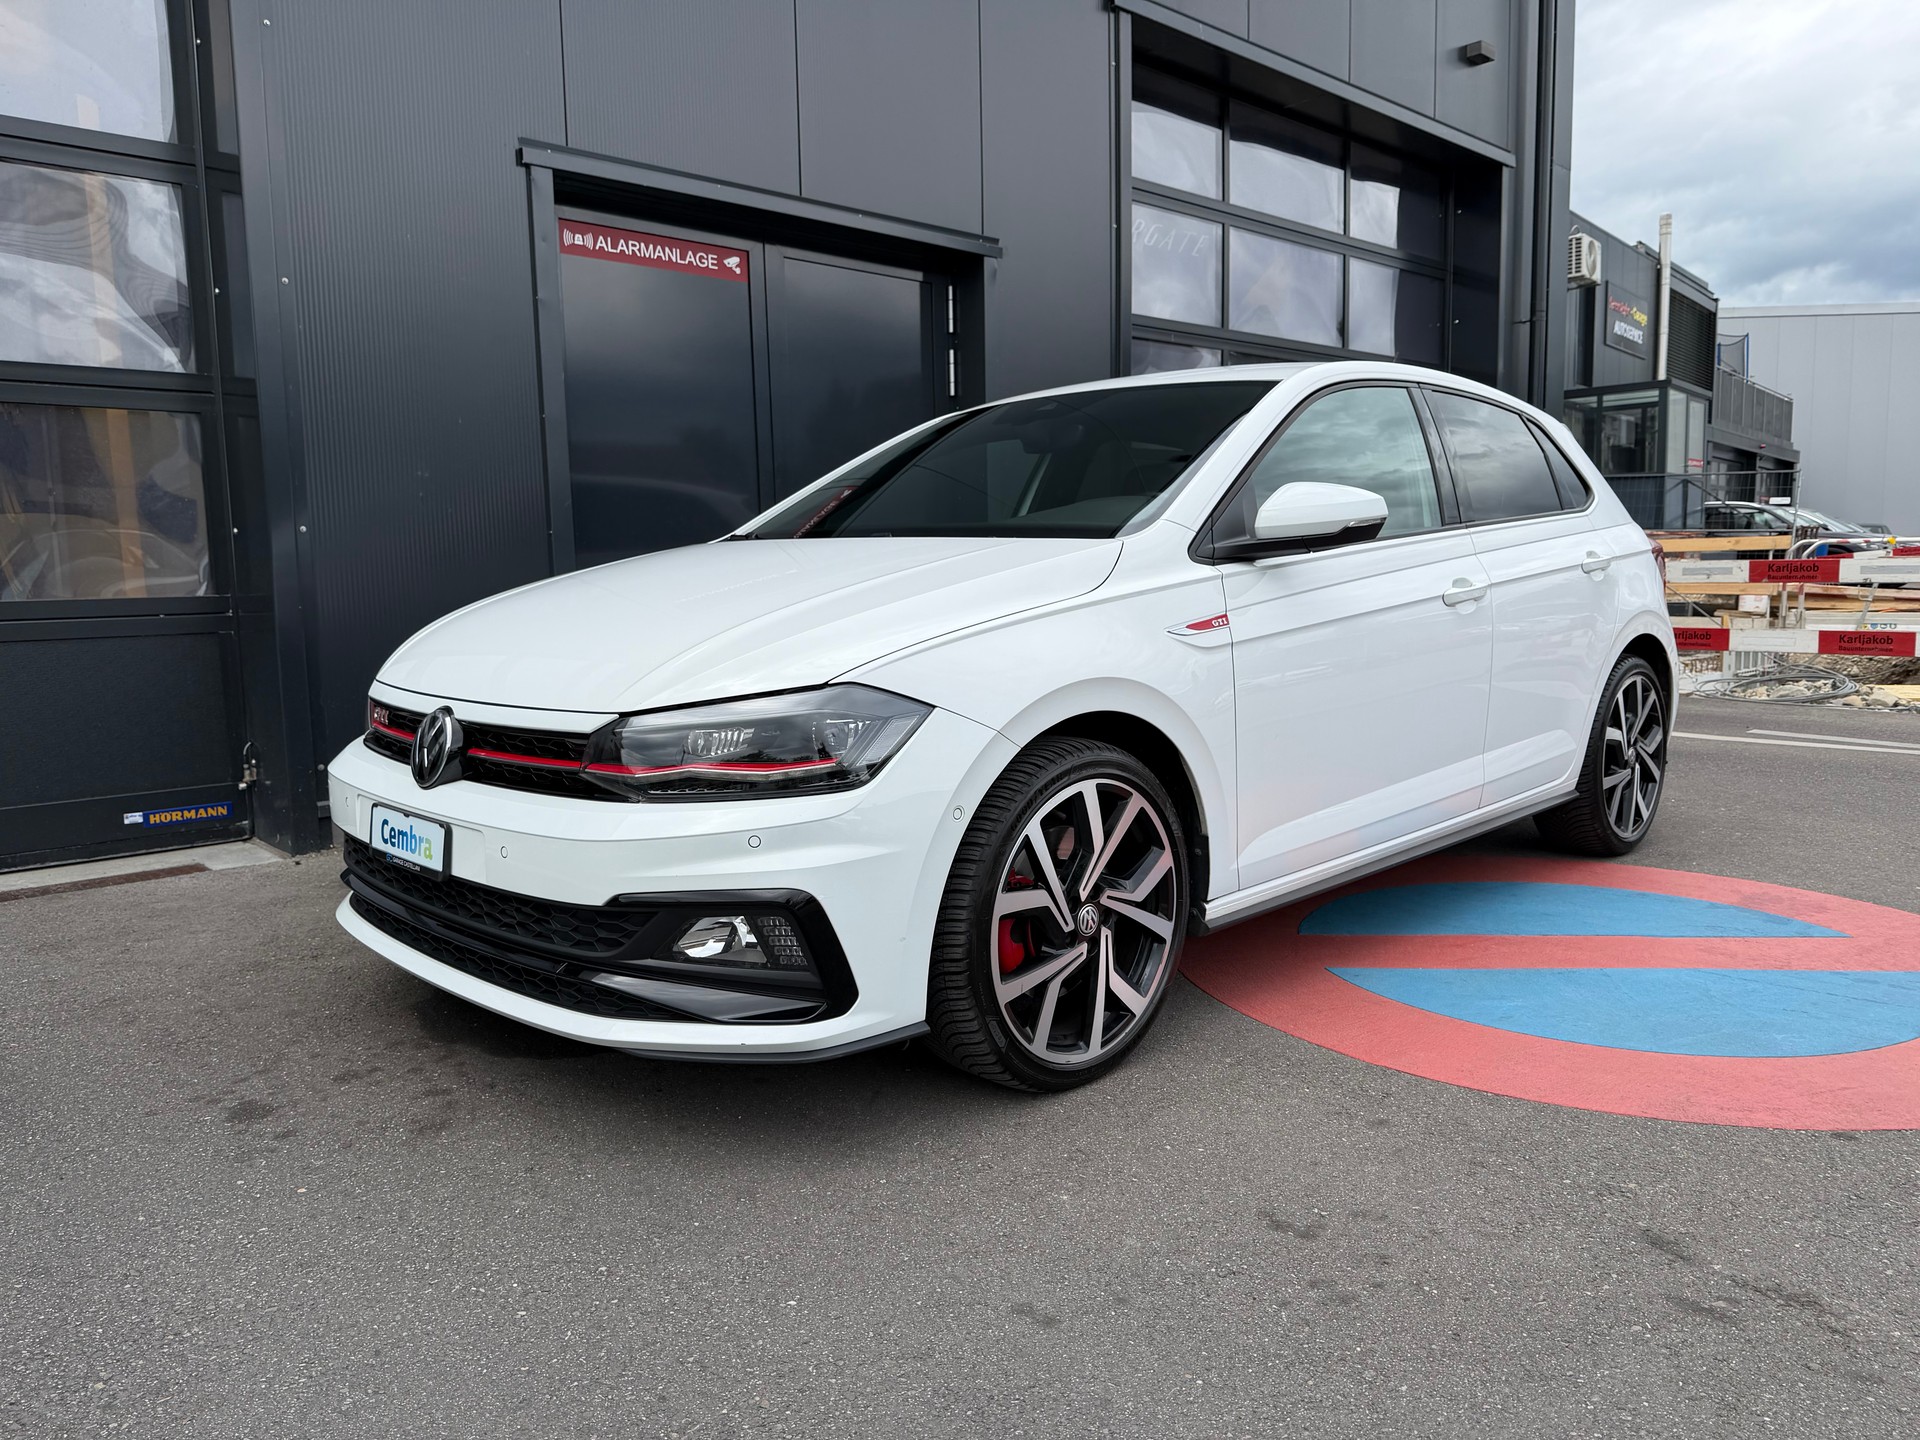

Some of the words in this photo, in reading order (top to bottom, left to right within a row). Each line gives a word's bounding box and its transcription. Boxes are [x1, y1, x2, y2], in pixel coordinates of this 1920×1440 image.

[596, 235, 718, 270] ALARMANLAGE
[1767, 562, 1820, 574] Karljakob
[1211, 617, 1228, 627] GTI
[1838, 633, 1894, 646] Karljakob
[380, 818, 433, 861] Cembra
